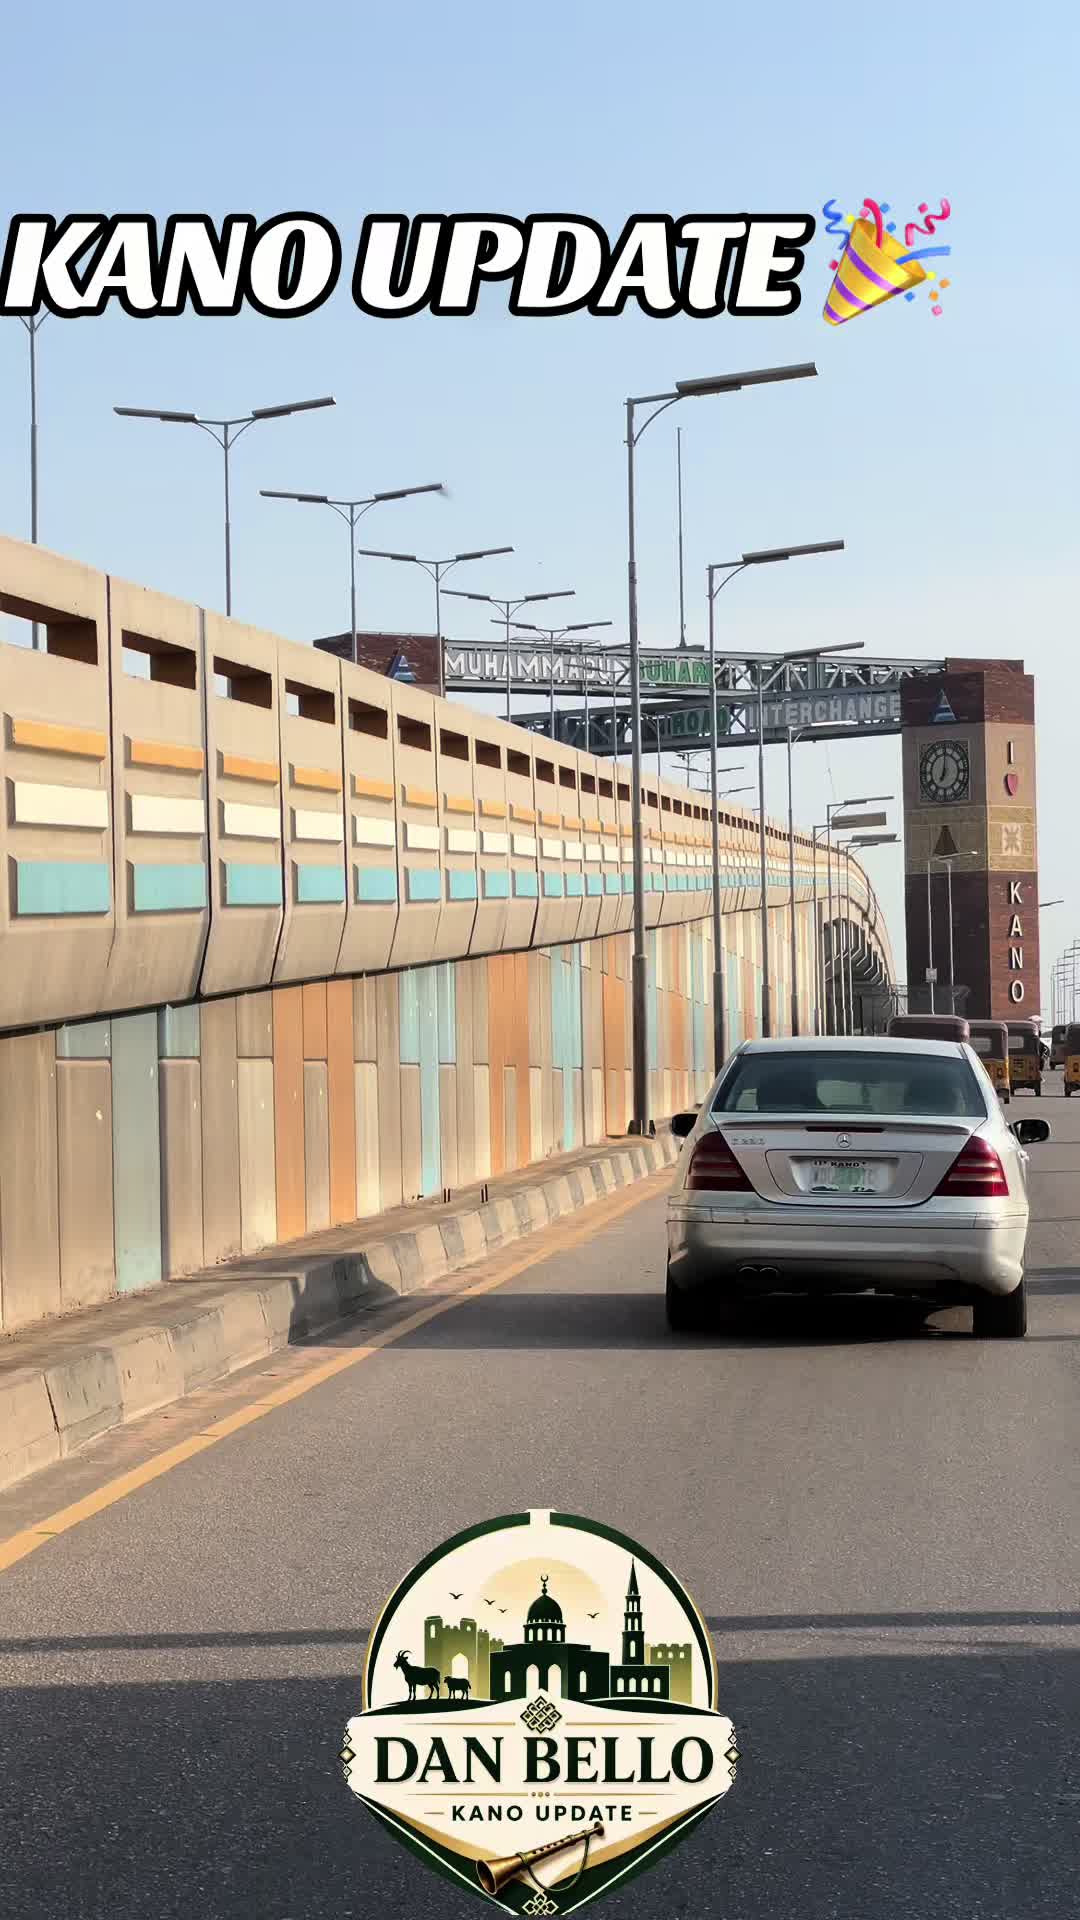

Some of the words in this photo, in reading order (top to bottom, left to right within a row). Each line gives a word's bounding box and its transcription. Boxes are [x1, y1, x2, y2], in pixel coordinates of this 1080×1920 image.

[444, 651, 611, 682] MUHAMMADU
[748, 695, 900, 728] INTERCHANGE
[1007, 740, 1014, 764] I
[1009, 880, 1025, 1003] KANO
